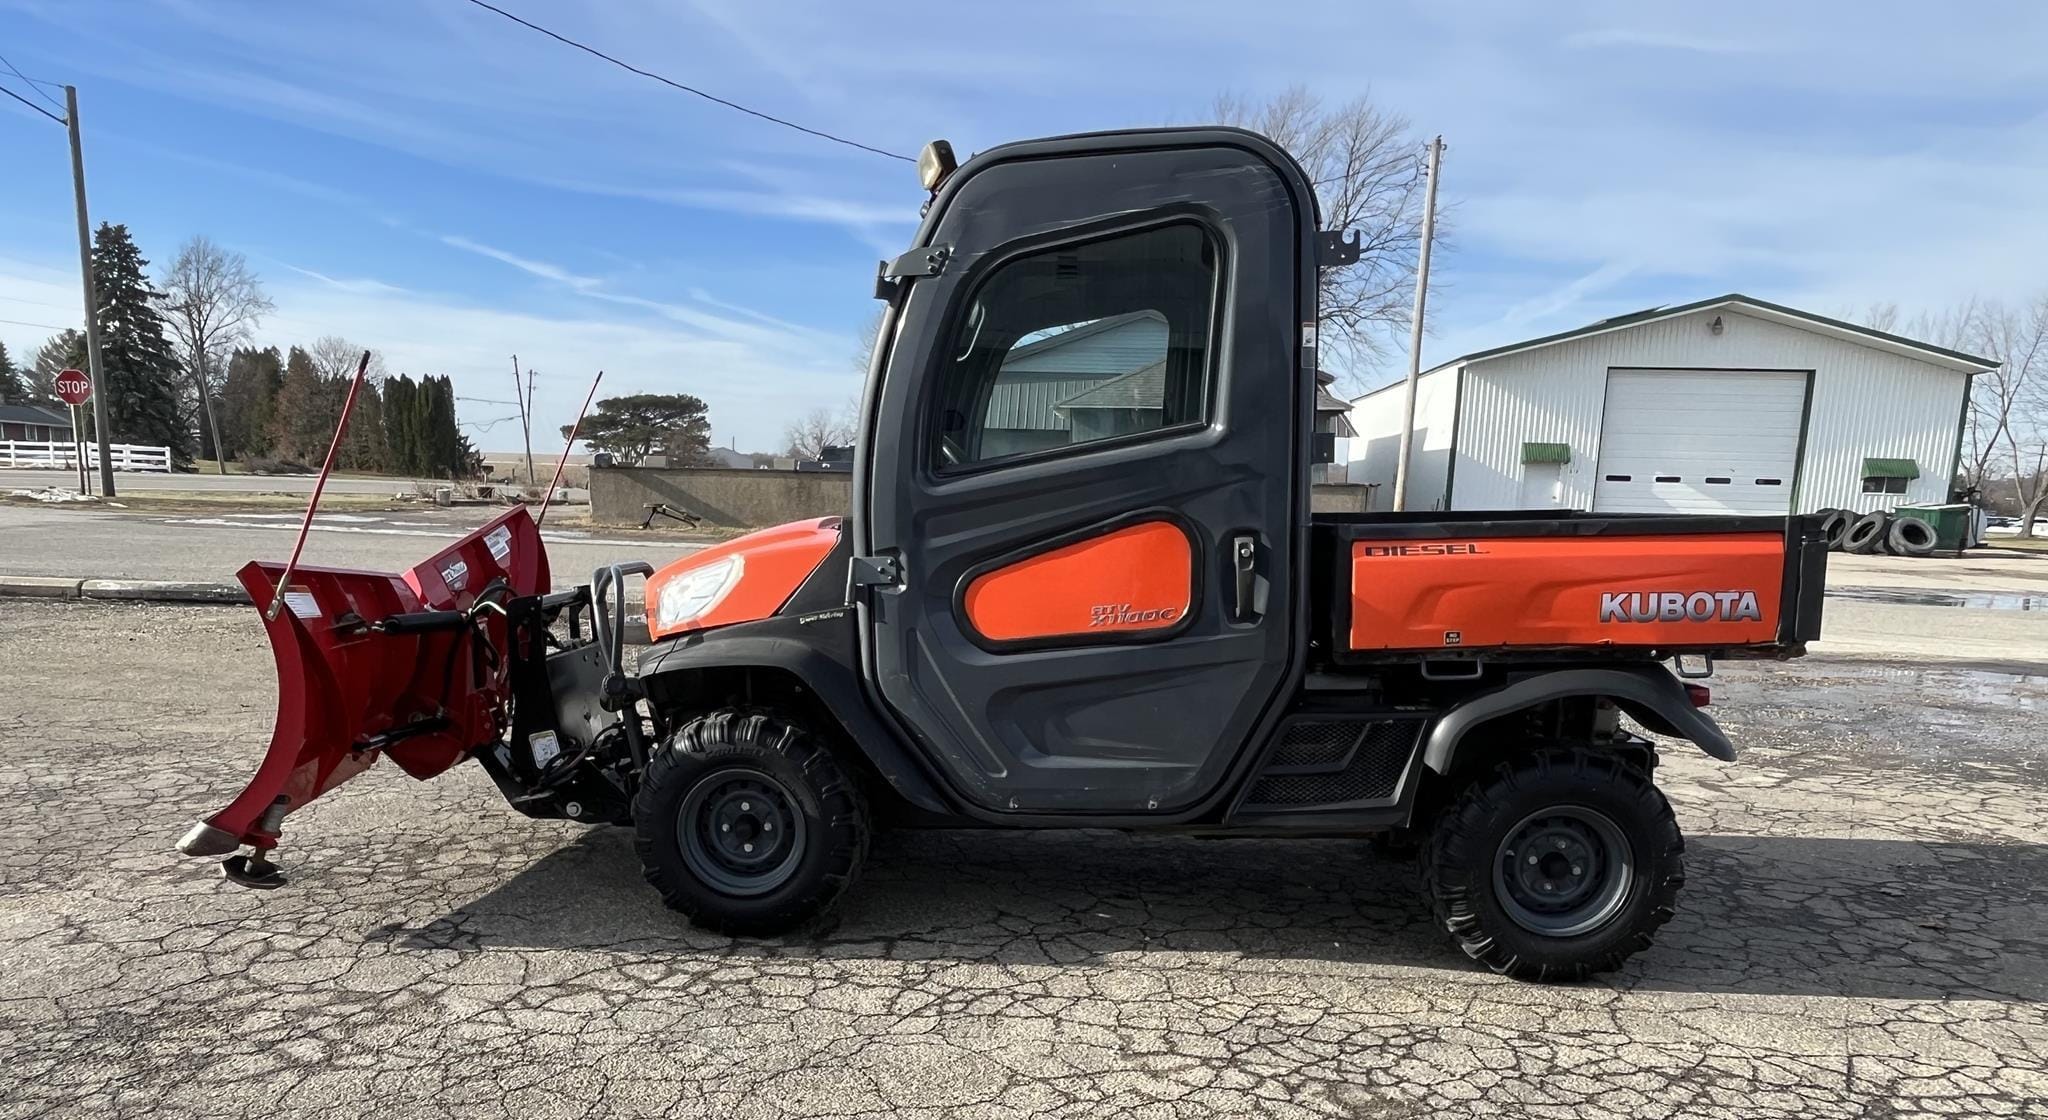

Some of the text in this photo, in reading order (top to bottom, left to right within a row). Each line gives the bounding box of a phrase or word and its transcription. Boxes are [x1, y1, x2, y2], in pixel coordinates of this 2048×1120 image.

[57, 380, 89, 394] STOP
[1365, 544, 1490, 557] DIESEL
[1599, 591, 1762, 623] KUBOTA
